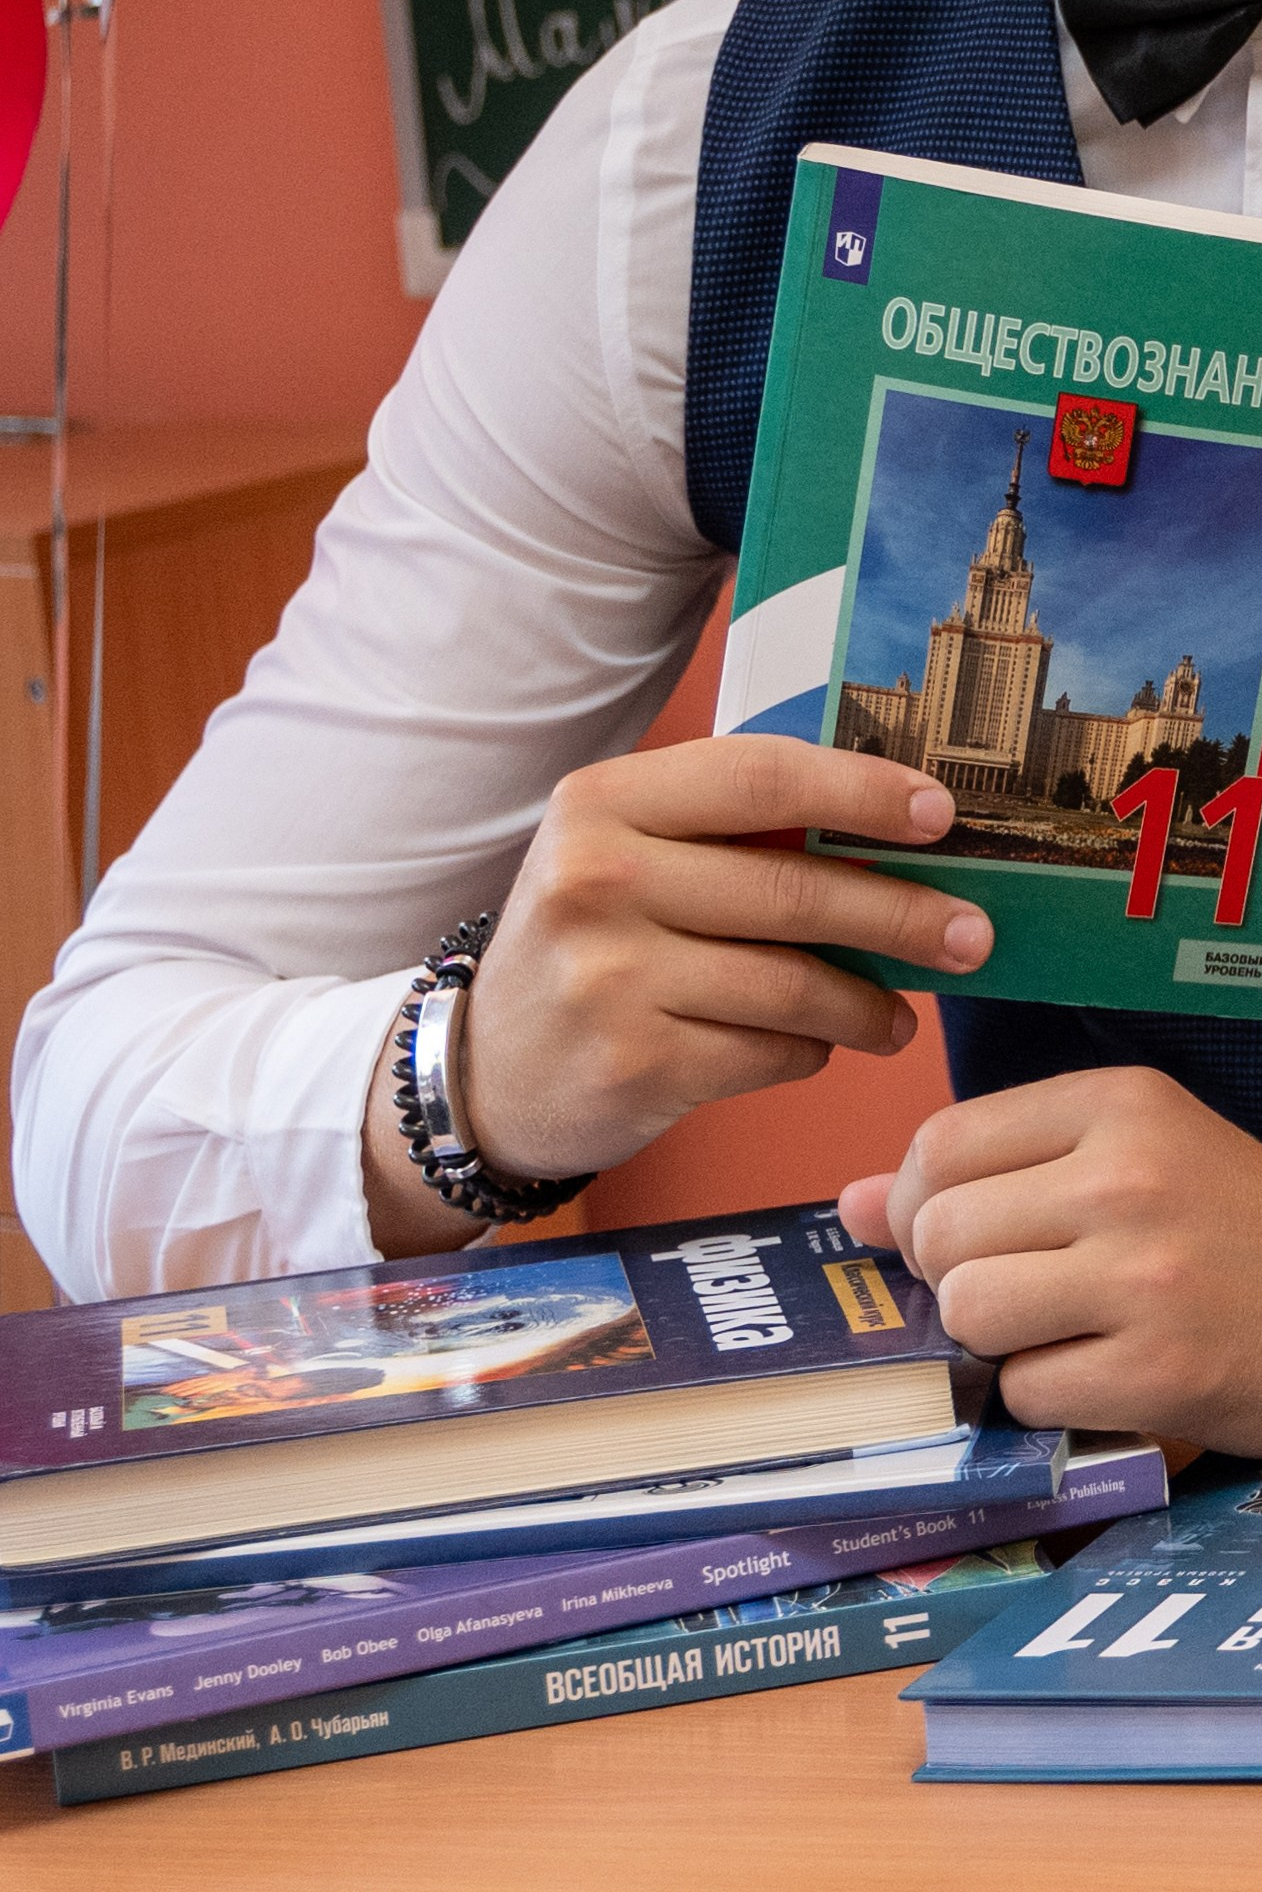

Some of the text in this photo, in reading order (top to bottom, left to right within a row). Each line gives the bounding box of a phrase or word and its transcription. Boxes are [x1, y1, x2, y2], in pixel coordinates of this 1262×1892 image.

[1203, 963, 1262, 980] УРОВЕНЬ
[58, 1692, 123, 1721] Virginia
[126, 1683, 175, 1708] Evans
[193, 1668, 244, 1693] Jenny
[248, 1656, 303, 1682] Dooley
[321, 1645, 354, 1665] Bob
[357, 1635, 399, 1657] Obee
[416, 1624, 453, 1645] Olga
[455, 1604, 545, 1638] Afanasyeva
[561, 1593, 598, 1613] Irina
[601, 1575, 675, 1605] Mikheeva
[701, 1549, 793, 1588] Spotlight
[915, 1515, 958, 1538] Book
[968, 1509, 987, 1526] 11
[1069, 1477, 1127, 1502] Publishing
[1013, 1591, 1208, 1658] 11
[546, 1647, 703, 1706] ВСЕОБЩАЯ
[715, 1624, 842, 1678] ИСТОРИЯ
[120, 1708, 390, 1772] В. Р. Мединский, А. О. Чубарьян
